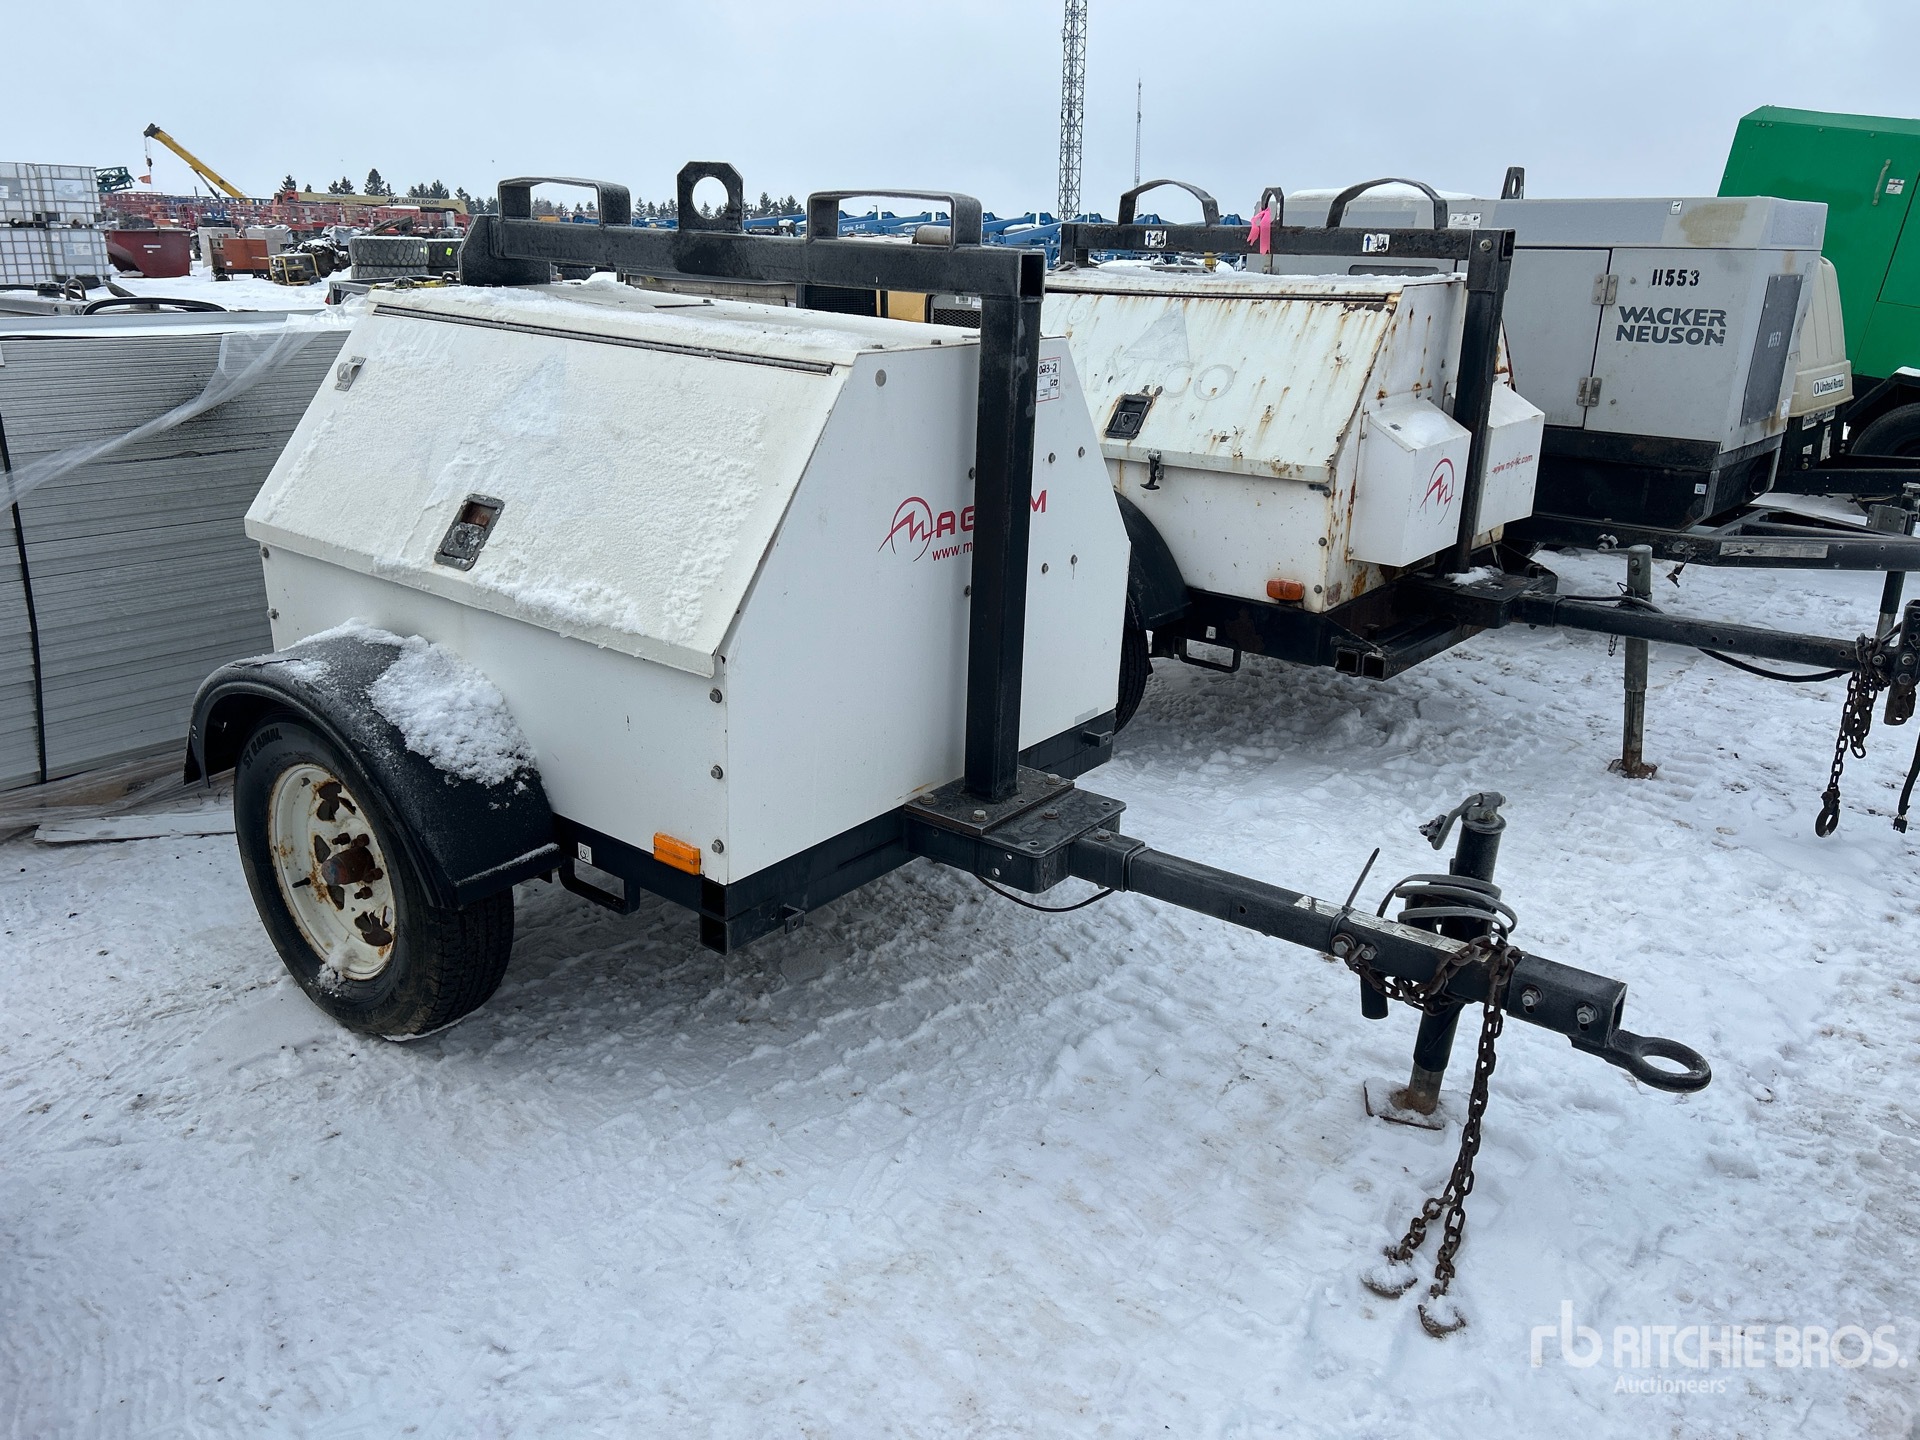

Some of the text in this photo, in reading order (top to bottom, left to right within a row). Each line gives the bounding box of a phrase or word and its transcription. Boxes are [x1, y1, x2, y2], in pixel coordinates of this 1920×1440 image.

[1651, 268, 1700, 287] 11553
[1618, 305, 1727, 328] WACKER
[1615, 324, 1726, 347] NEUSON
